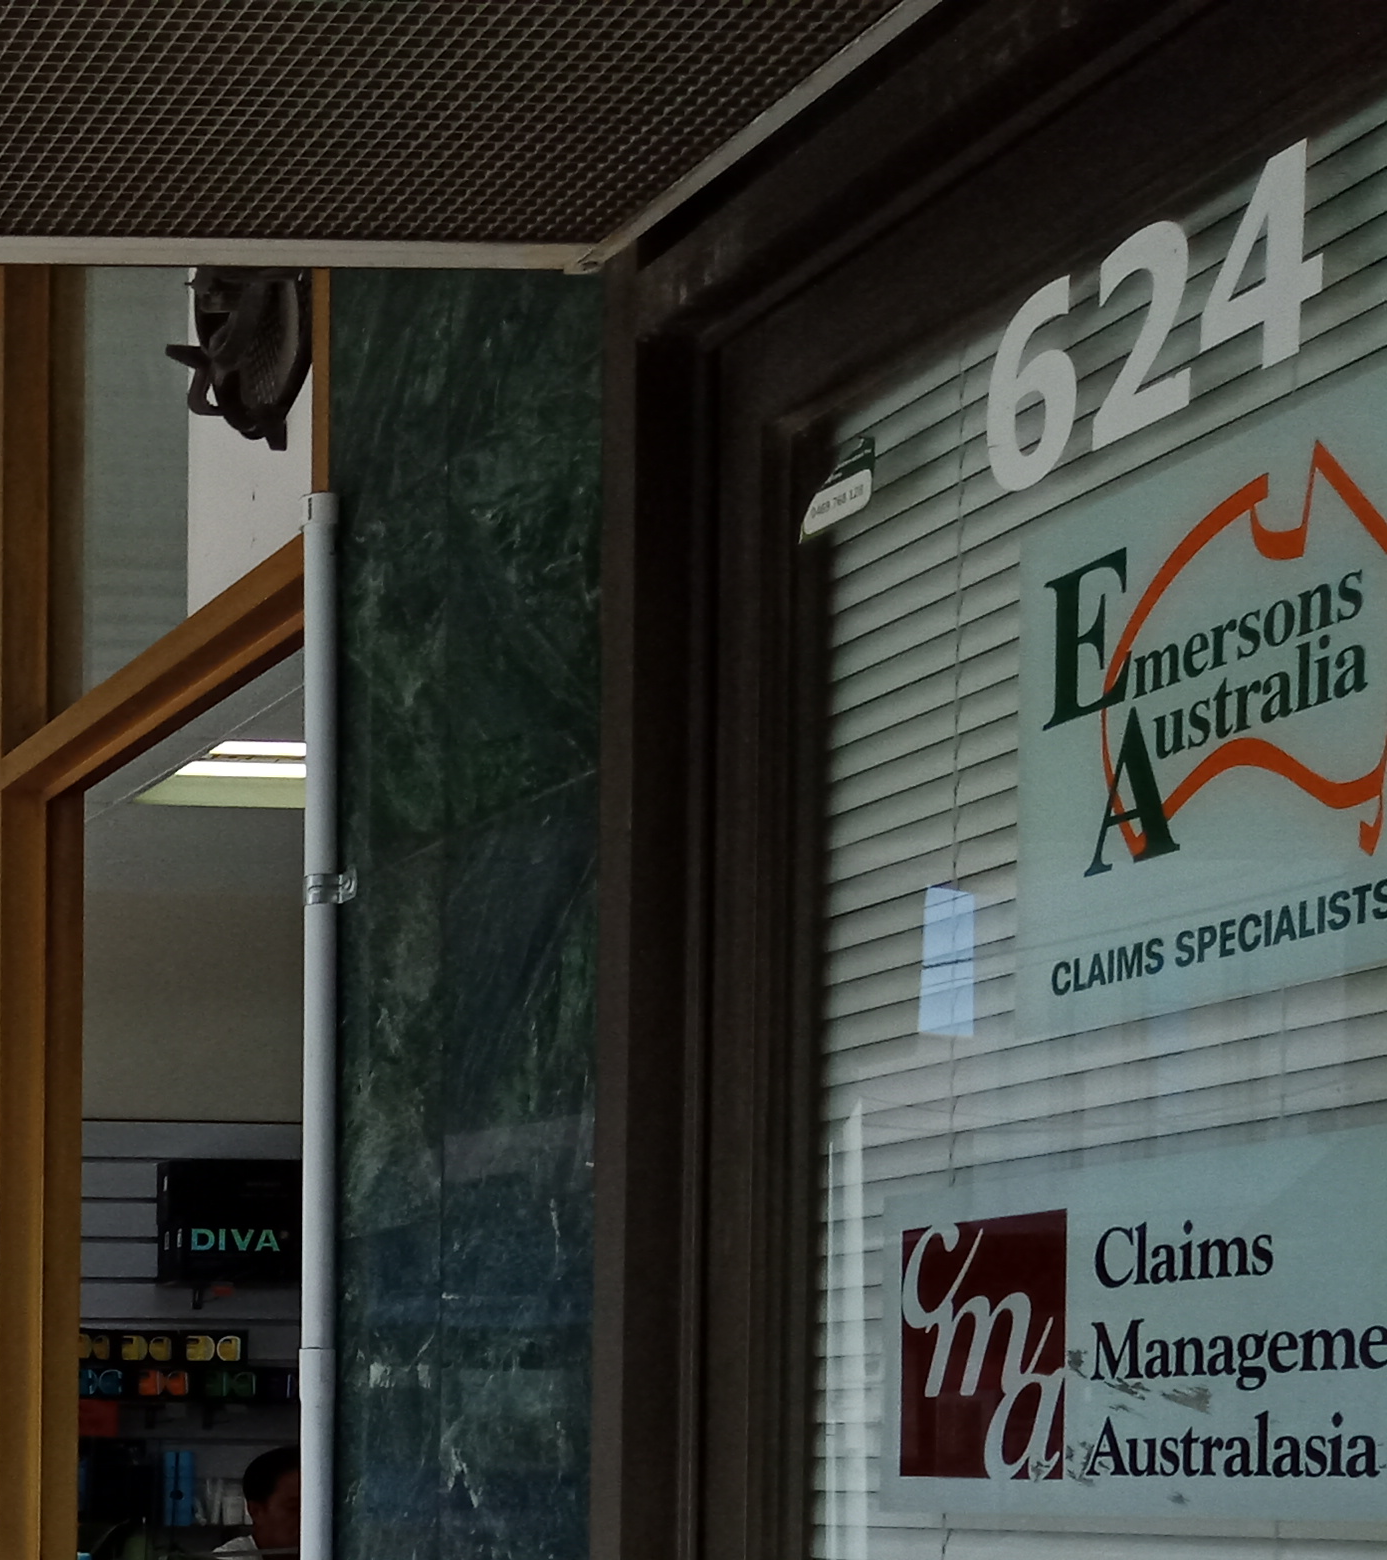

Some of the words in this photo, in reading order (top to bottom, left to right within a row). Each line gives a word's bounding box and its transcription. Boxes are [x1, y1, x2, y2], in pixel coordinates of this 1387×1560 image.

[987, 138, 1324, 492] 624
[1043, 547, 1365, 732] Emersons
[1084, 634, 1369, 878] Australia
[1051, 938, 1165, 997] CLAIMS
[1174, 877, 1387, 973] SPECIALISTS
[190, 1227, 281, 1252] DIVA
[1094, 1219, 1274, 1289] Claims
[1089, 1317, 1387, 1392] Manageme
[1085, 1410, 1381, 1480] Australasia
